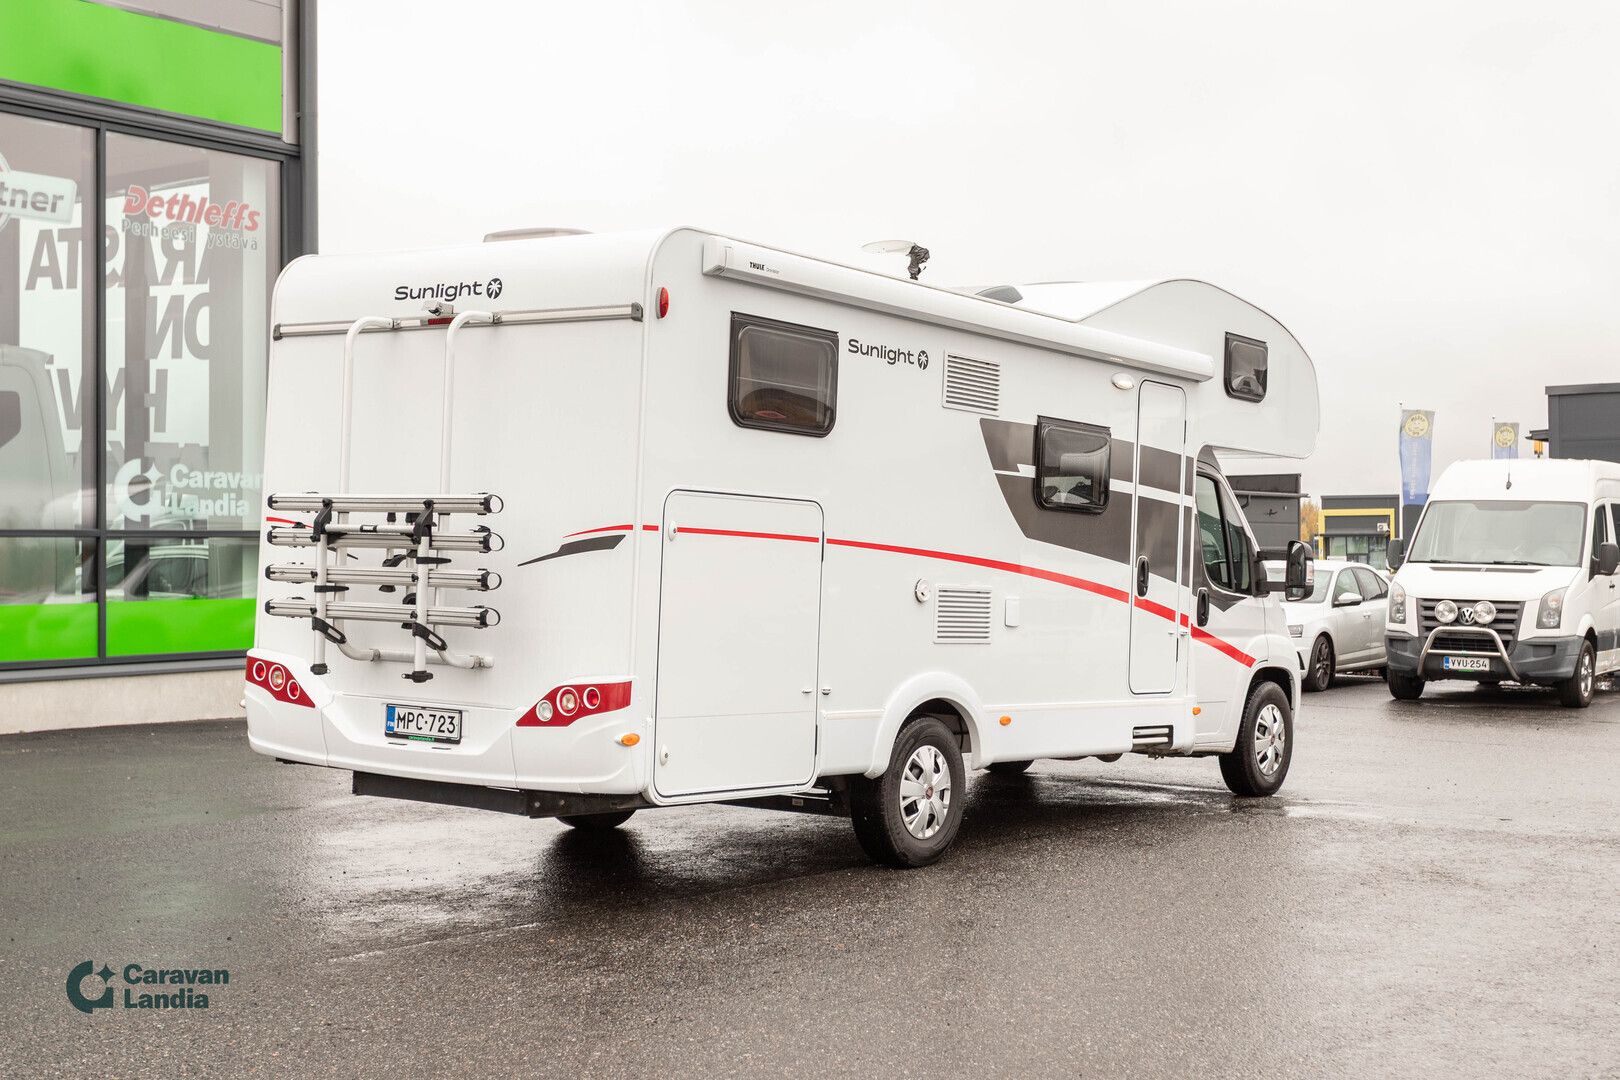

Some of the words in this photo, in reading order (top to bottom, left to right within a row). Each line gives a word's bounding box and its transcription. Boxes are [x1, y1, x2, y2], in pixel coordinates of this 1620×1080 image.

[123, 184, 262, 231] Dethleffs
[749, 261, 765, 271] THULE
[394, 280, 483, 302] Sunlight
[847, 338, 915, 366] Sunlight
[171, 491, 250, 517] Landia
[396, 711, 456, 734] MPC-723
